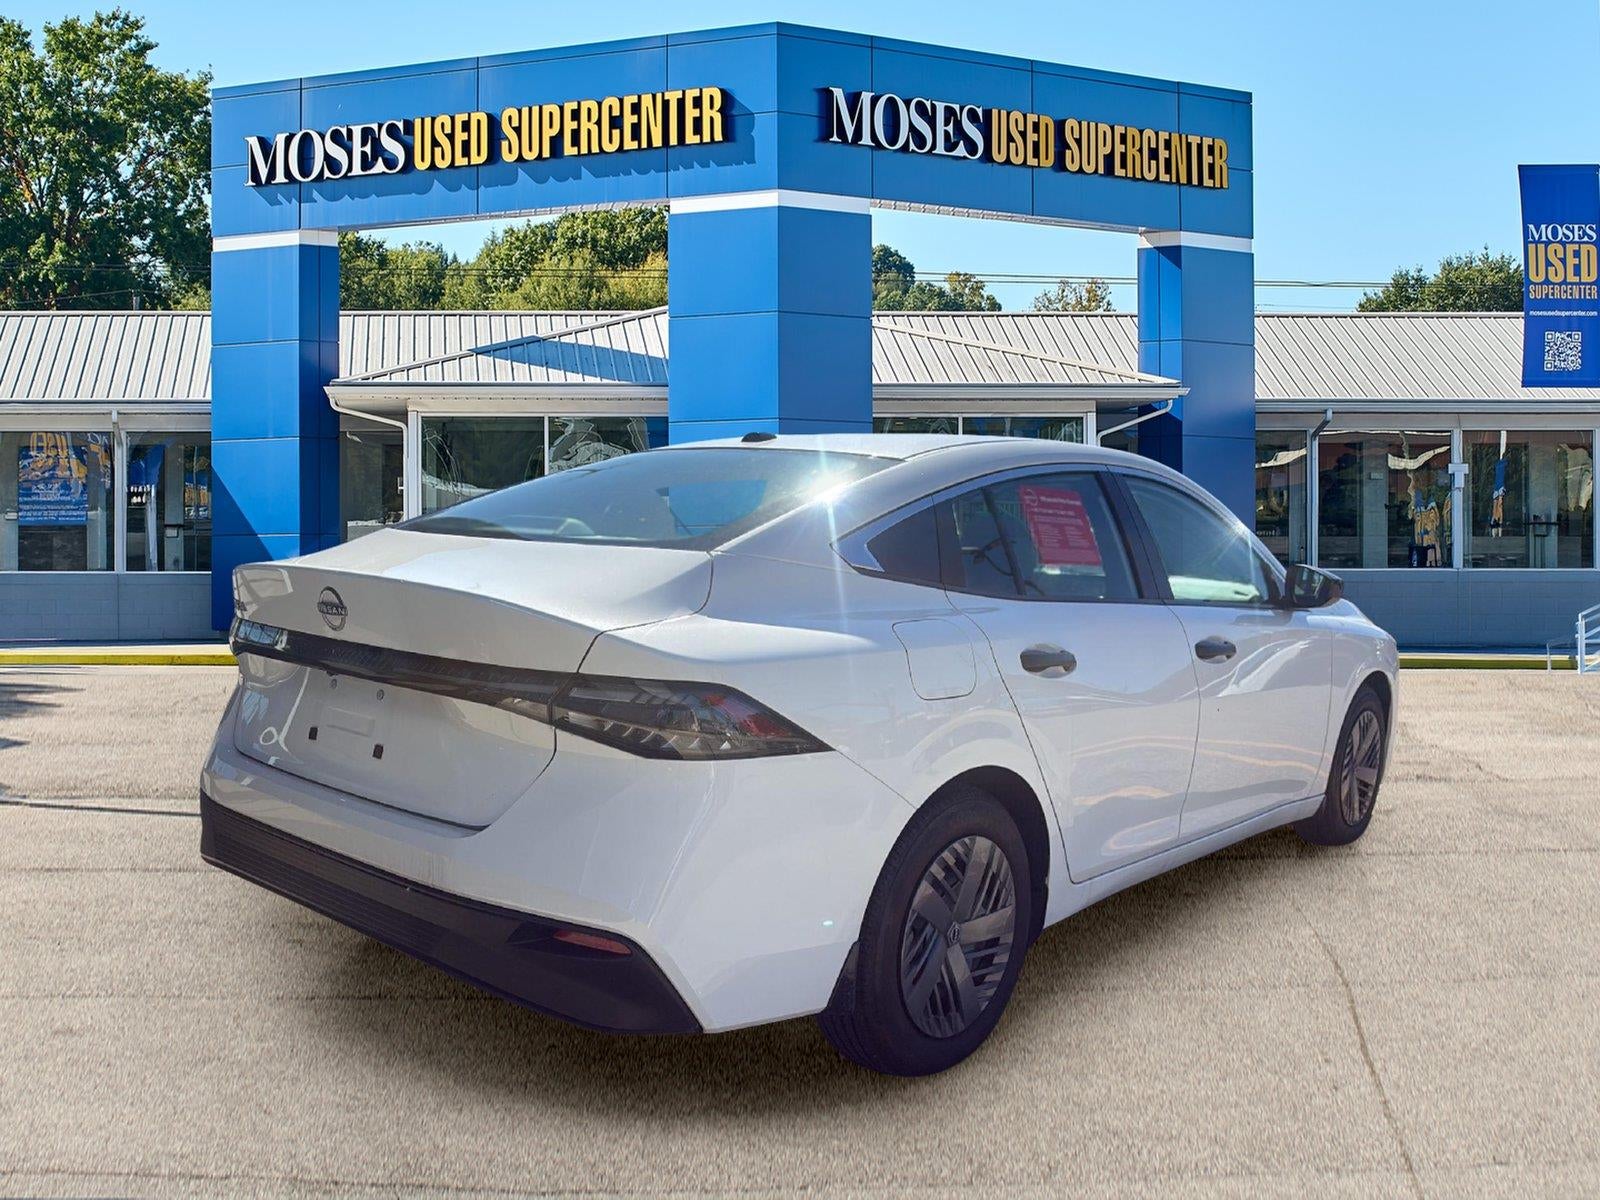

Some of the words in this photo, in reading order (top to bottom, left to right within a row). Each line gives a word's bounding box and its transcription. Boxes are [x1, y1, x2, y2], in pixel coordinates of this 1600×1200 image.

[244, 120, 407, 186] MOSES
[412, 110, 490, 171] USED
[501, 86, 724, 163] SUPERCENTER
[828, 86, 984, 159] MOSES
[991, 108, 1055, 167] USED
[1064, 117, 1229, 189] SUPERCENTER
[1527, 223, 1597, 242] MOSES
[1528, 243, 1598, 283] USED
[1529, 284, 1598, 299] SUPERCENTER
